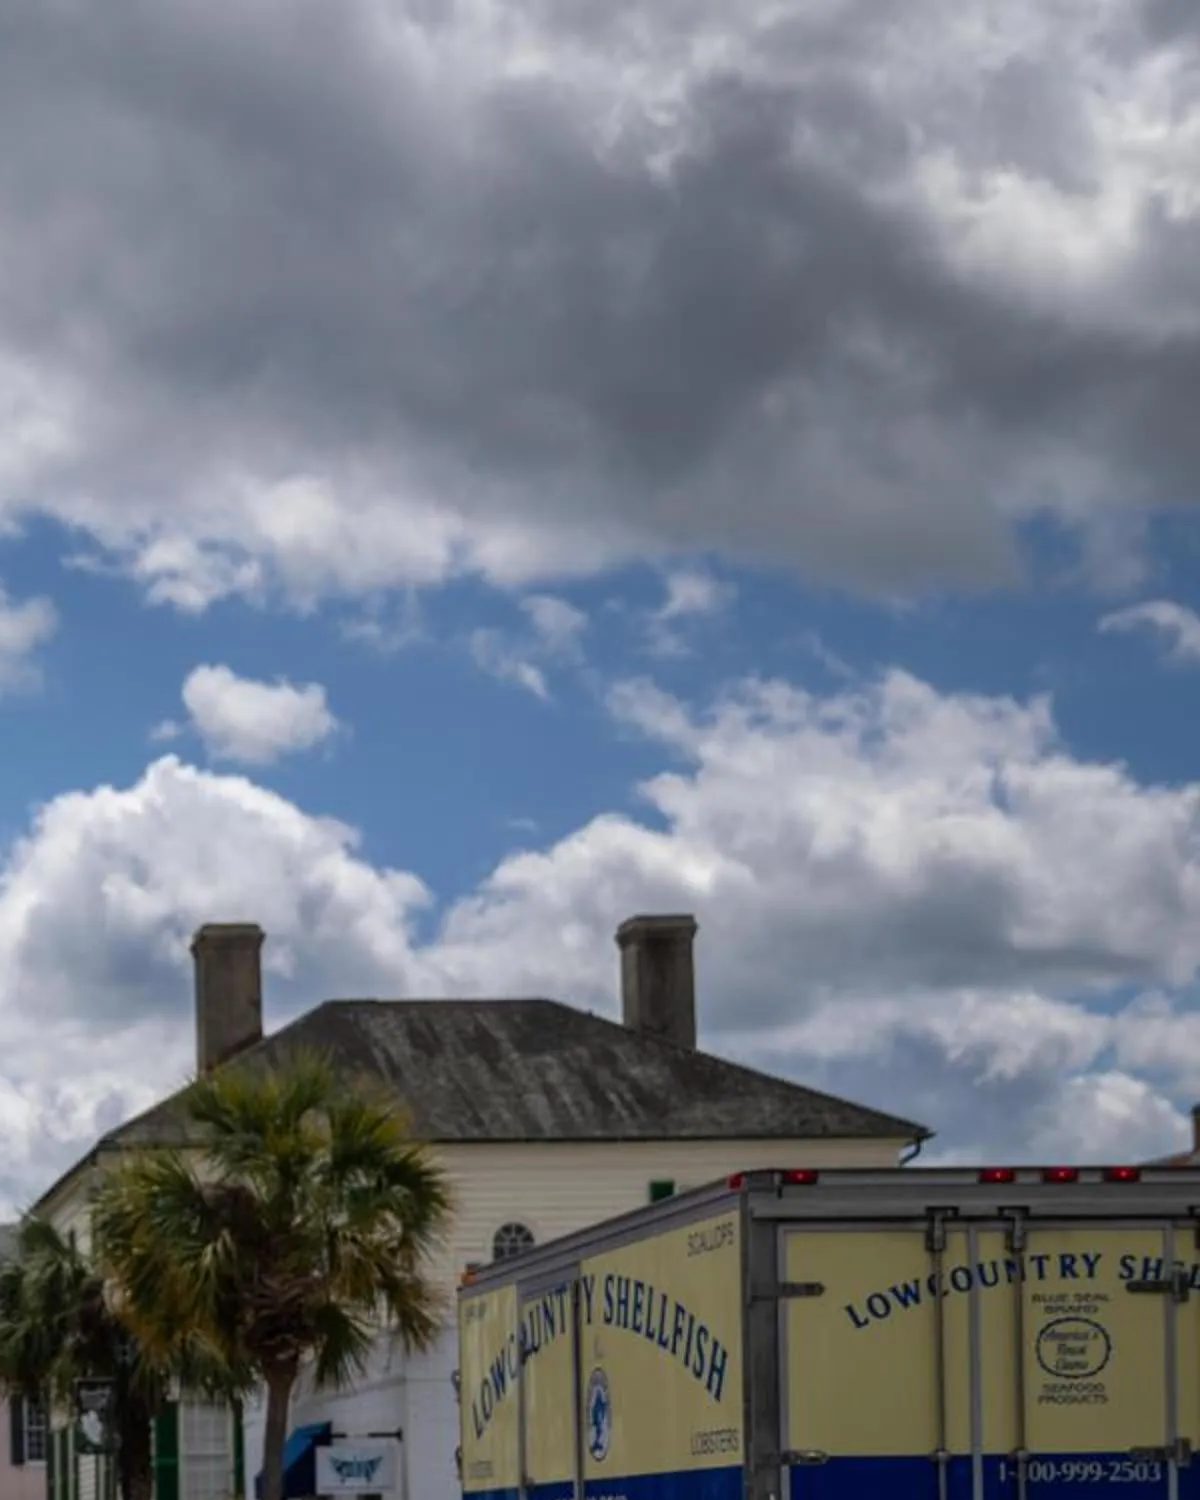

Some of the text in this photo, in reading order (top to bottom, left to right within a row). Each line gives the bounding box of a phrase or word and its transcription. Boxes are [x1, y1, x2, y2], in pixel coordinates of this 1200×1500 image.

[603, 1273, 728, 1402] SHELLFISH
[1043, 1382, 1105, 1393] SEAFOOD
[1037, 1394, 1109, 1405] PRODUCTS
[999, 1461, 1162, 1484] 1-00-999-2503
